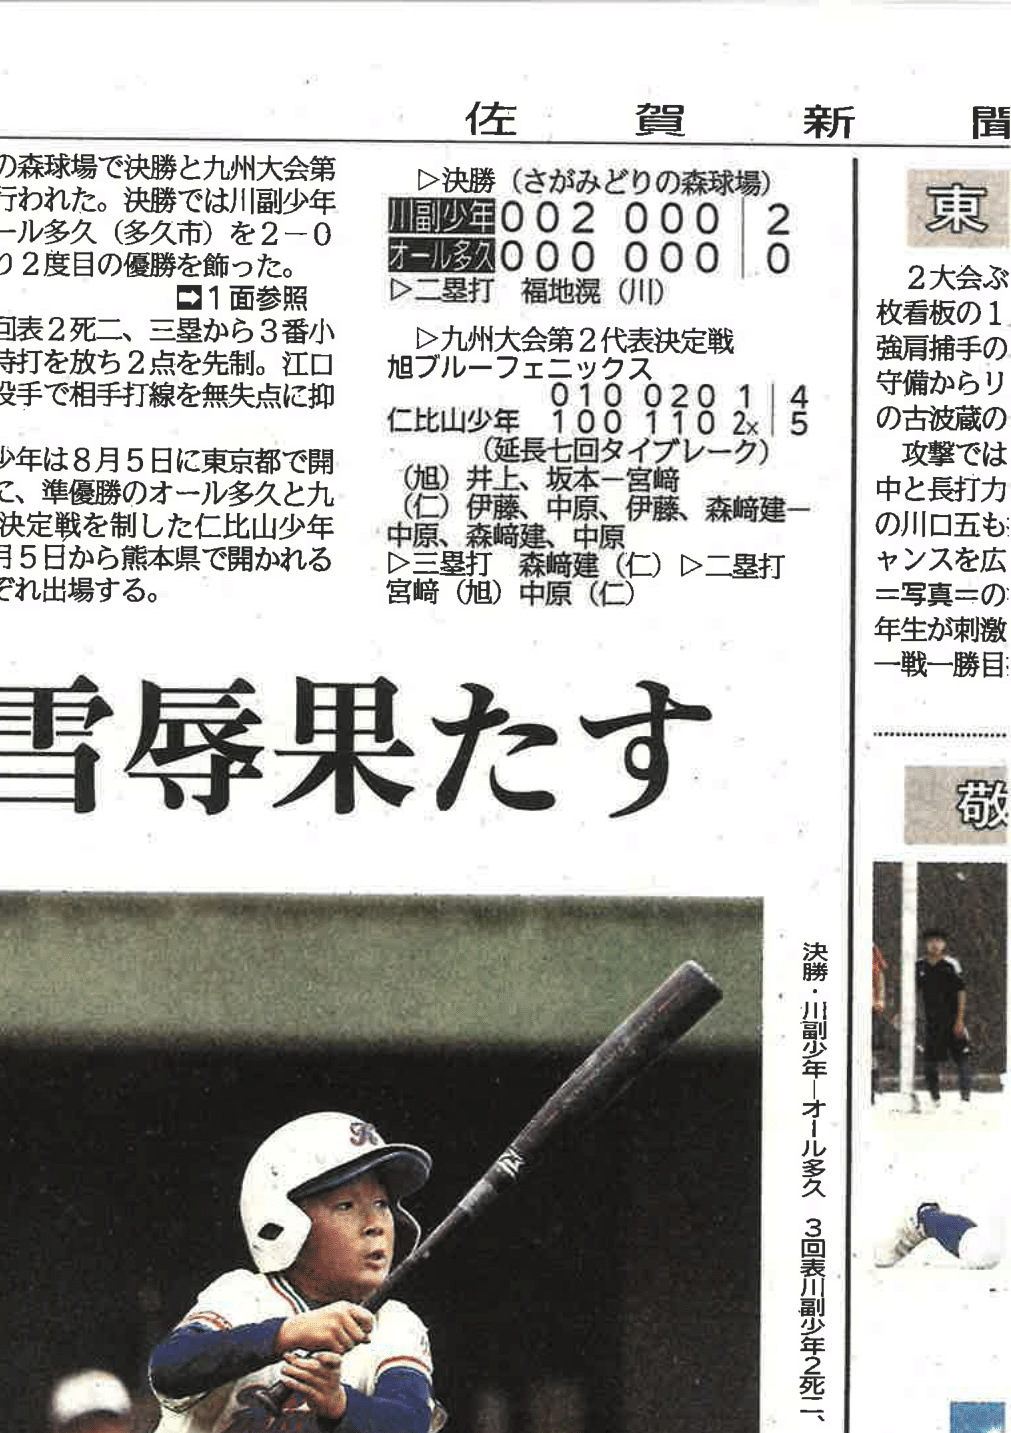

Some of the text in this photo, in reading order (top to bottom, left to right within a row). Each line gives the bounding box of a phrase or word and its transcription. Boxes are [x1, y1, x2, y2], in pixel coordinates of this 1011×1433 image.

[388, 197, 495, 233] 川副少年
[767, 203, 790, 235] 2
[925, 182, 988, 234] 東
[388, 237, 495, 272] オール多久
[767, 242, 789, 274] 0
[210, 285, 307, 311] 1面参照
[388, 355, 653, 381] 旭ブルーフェニックス
[739, 384, 751, 409] 1
[789, 384, 809, 408] 4
[387, 407, 520, 434] 仁比山少年
[790, 411, 809, 437] 5
[876, 511, 1009, 537] の川口五も
[876, 582, 1009, 606] ＝写真＝の
[874, 651, 1009, 678] 一戦一勝目
